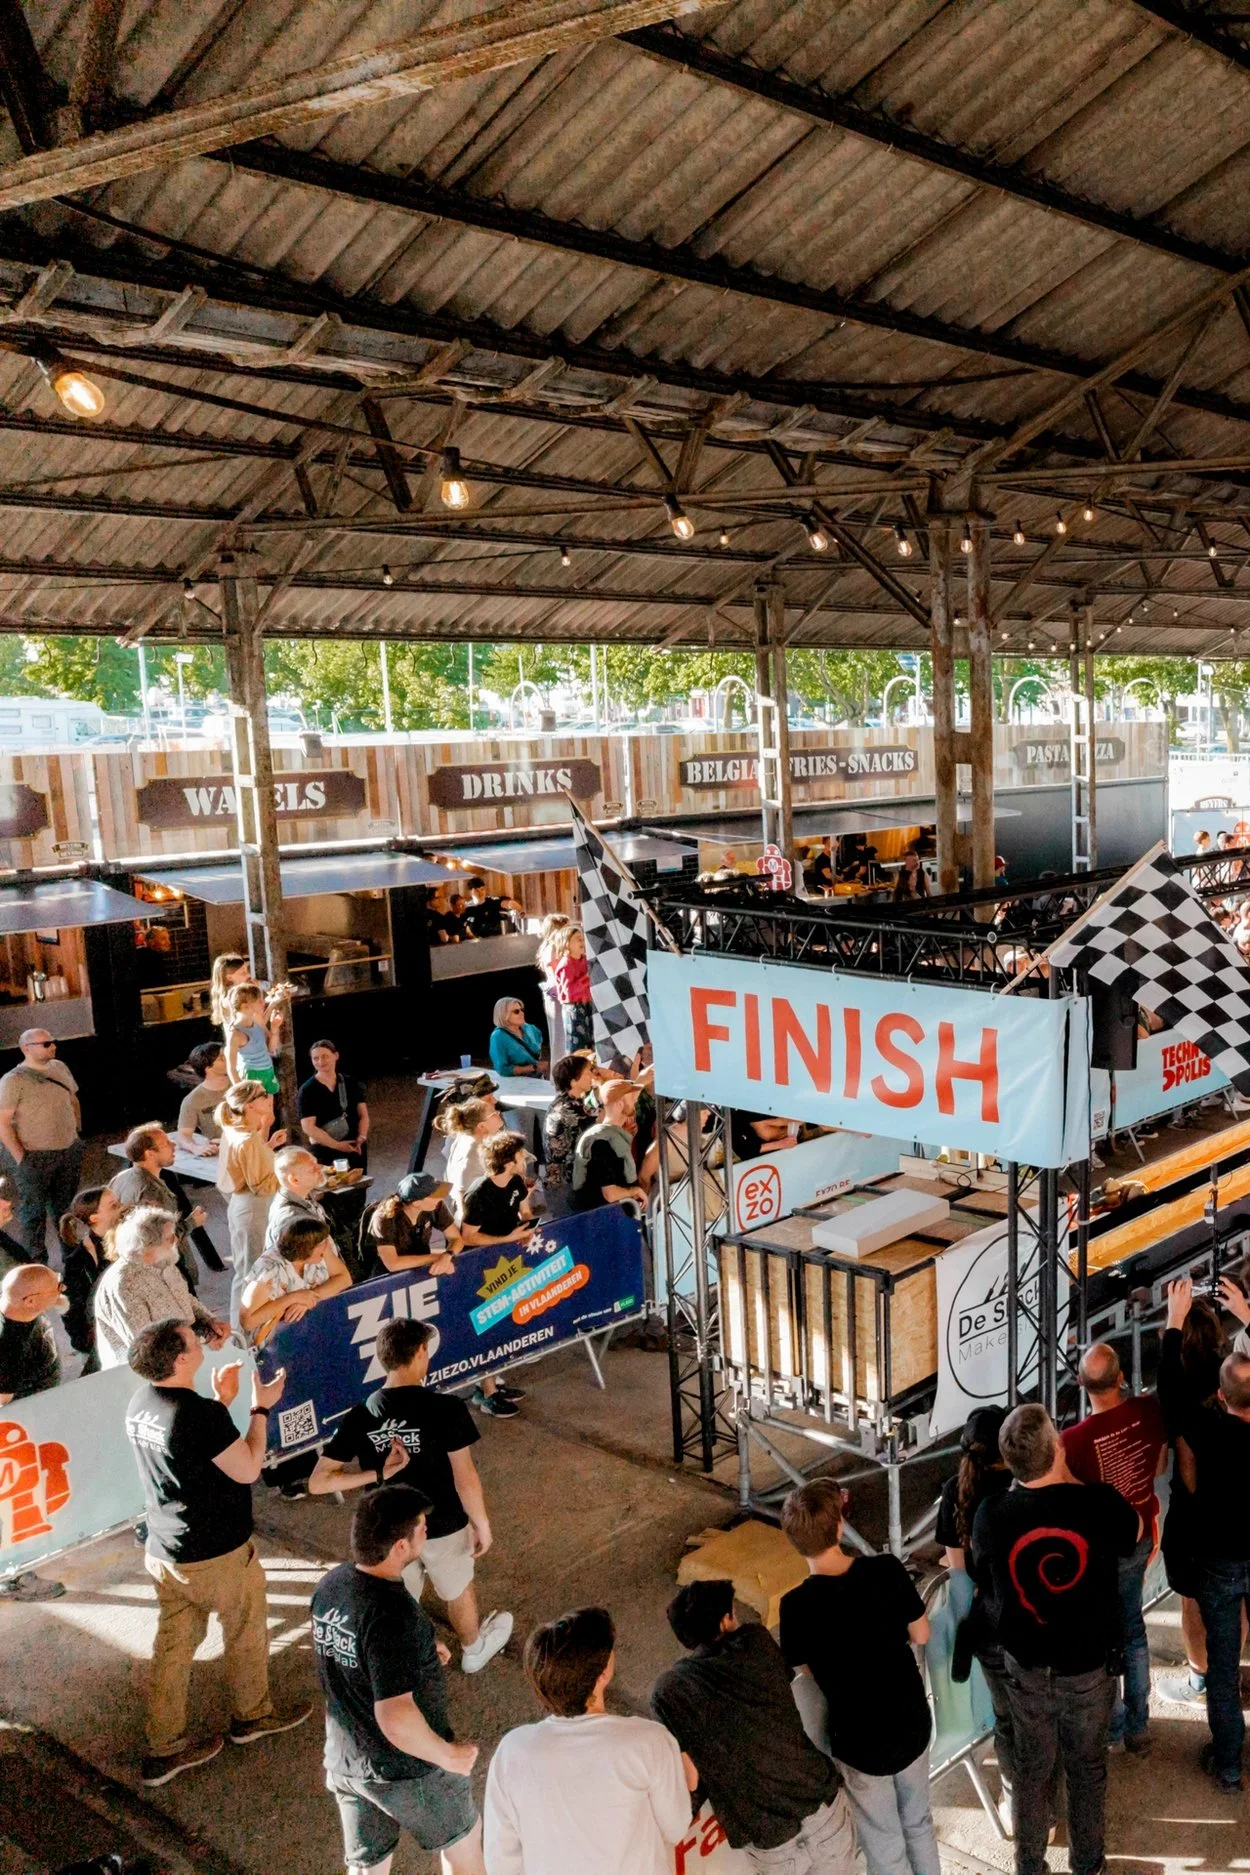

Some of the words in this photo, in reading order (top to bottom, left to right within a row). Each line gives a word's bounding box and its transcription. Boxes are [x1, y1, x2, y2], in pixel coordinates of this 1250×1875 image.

[1027, 744, 1070, 763] PASTA
[461, 768, 572, 800] DRINKS
[687, 759, 760, 784] BELGIA
[183, 781, 326, 816] WAELS
[690, 986, 1000, 1123] FINISH
[476, 1254, 567, 1325] STEM-ACTIVITEIT
[486, 1273, 508, 1294] VIND
[508, 1264, 518, 1279] JE
[518, 1305, 530, 1318] IN
[529, 1270, 583, 1310] VLAANDEREN
[347, 1277, 440, 1344] ZIE
[959, 1314, 986, 1338] De
